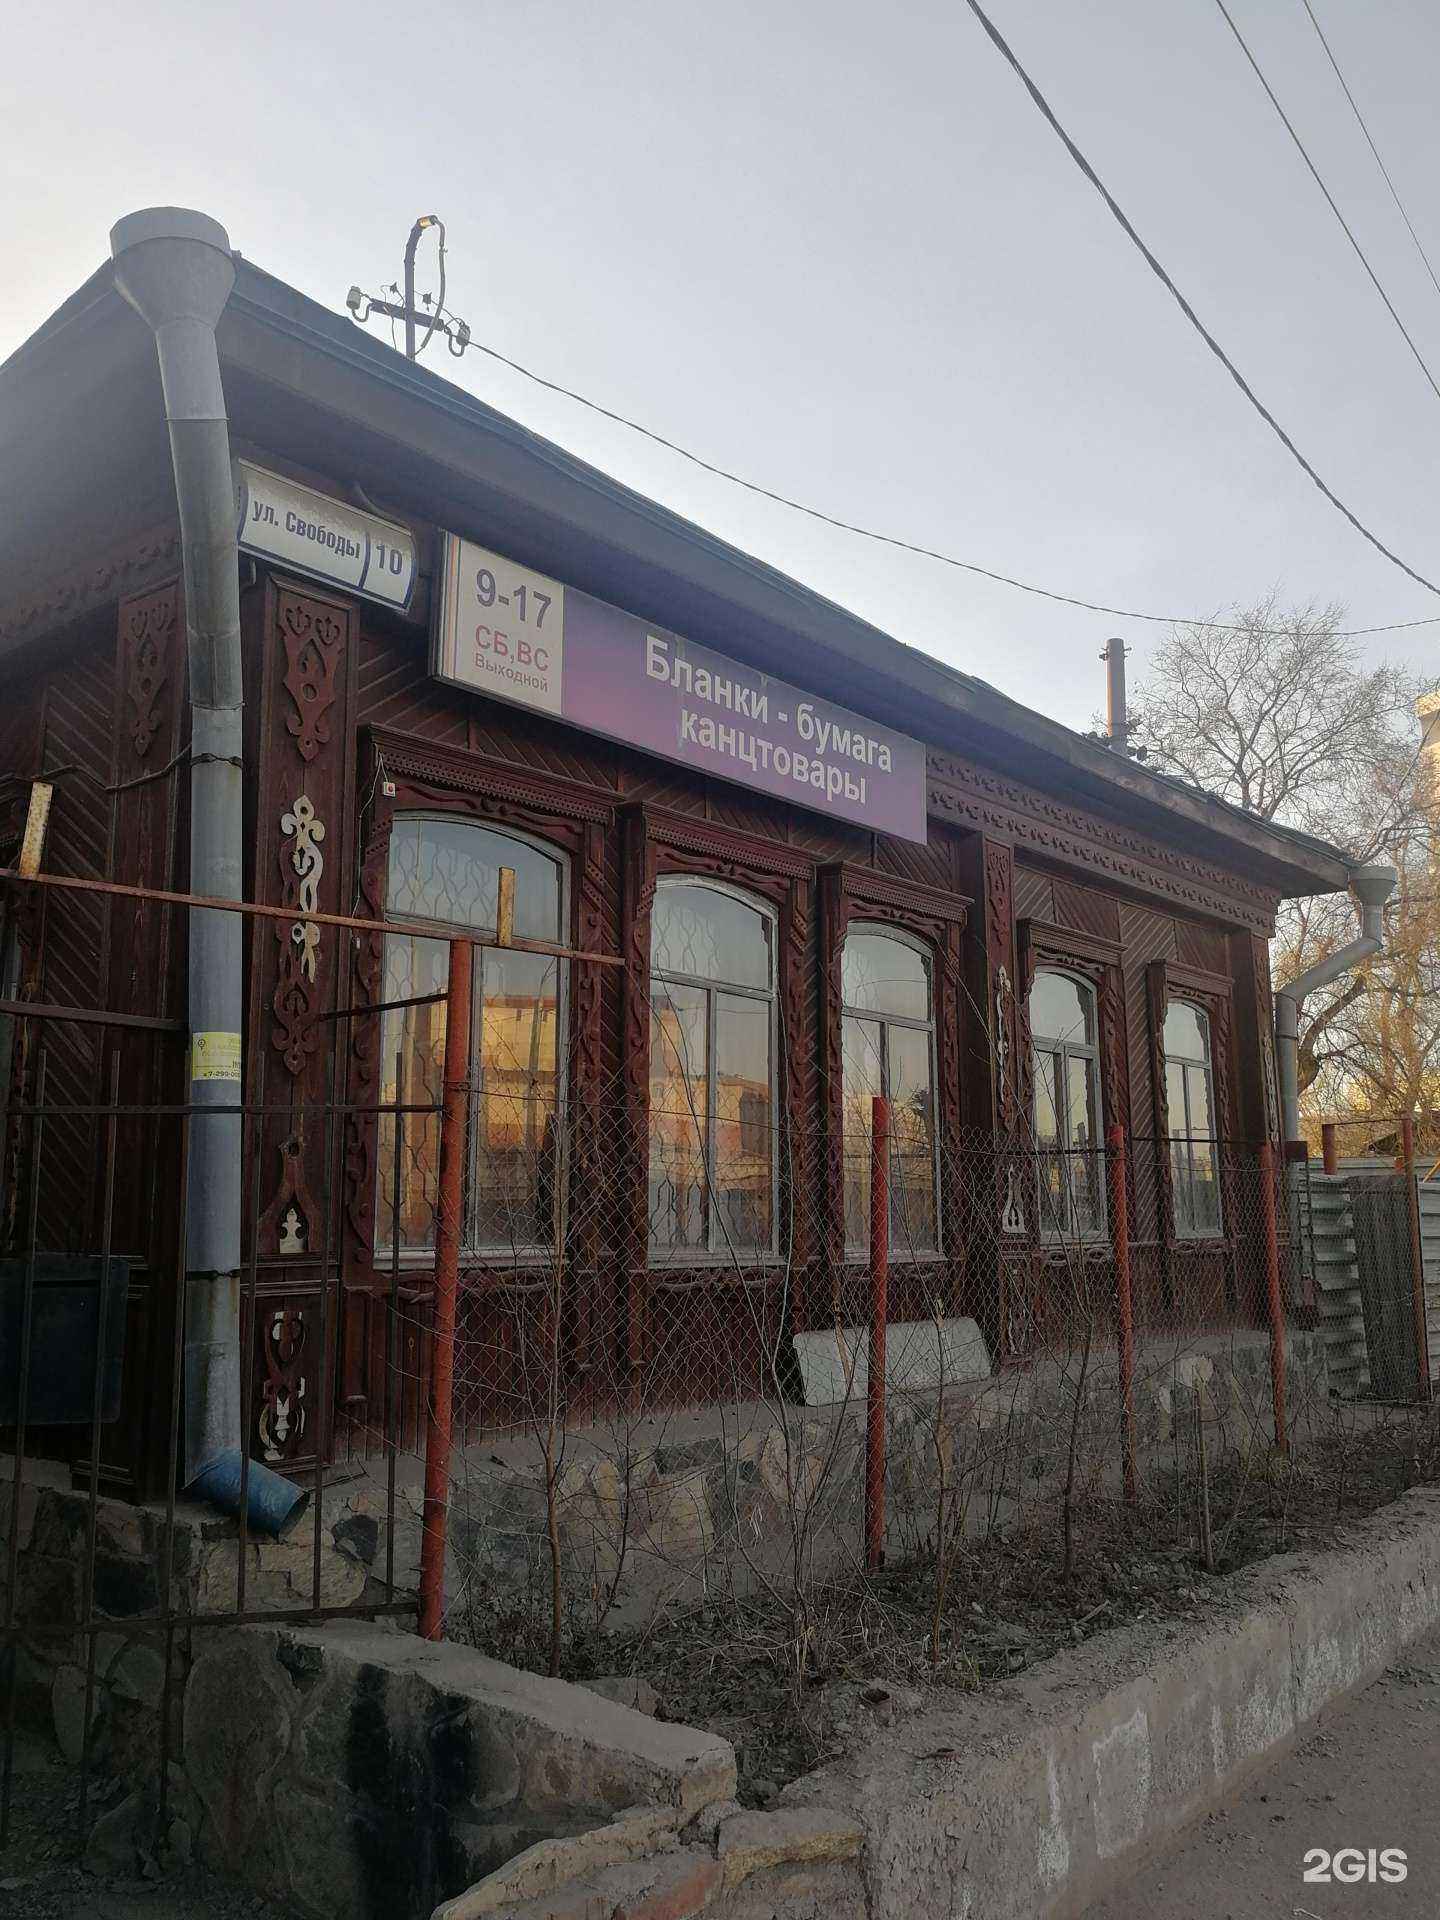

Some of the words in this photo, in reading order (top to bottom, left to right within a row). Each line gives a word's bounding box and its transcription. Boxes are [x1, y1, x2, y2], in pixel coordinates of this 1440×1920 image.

[252, 501, 279, 526] ул.
[286, 511, 360, 558] Свободы
[376, 544, 402, 574] 10
[476, 568, 551, 628] 9-17
[475, 652, 548, 692] Выходной
[646, 635, 768, 724] Бланки
[797, 703, 892, 772] бумага
[681, 709, 866, 804] канцтовары
